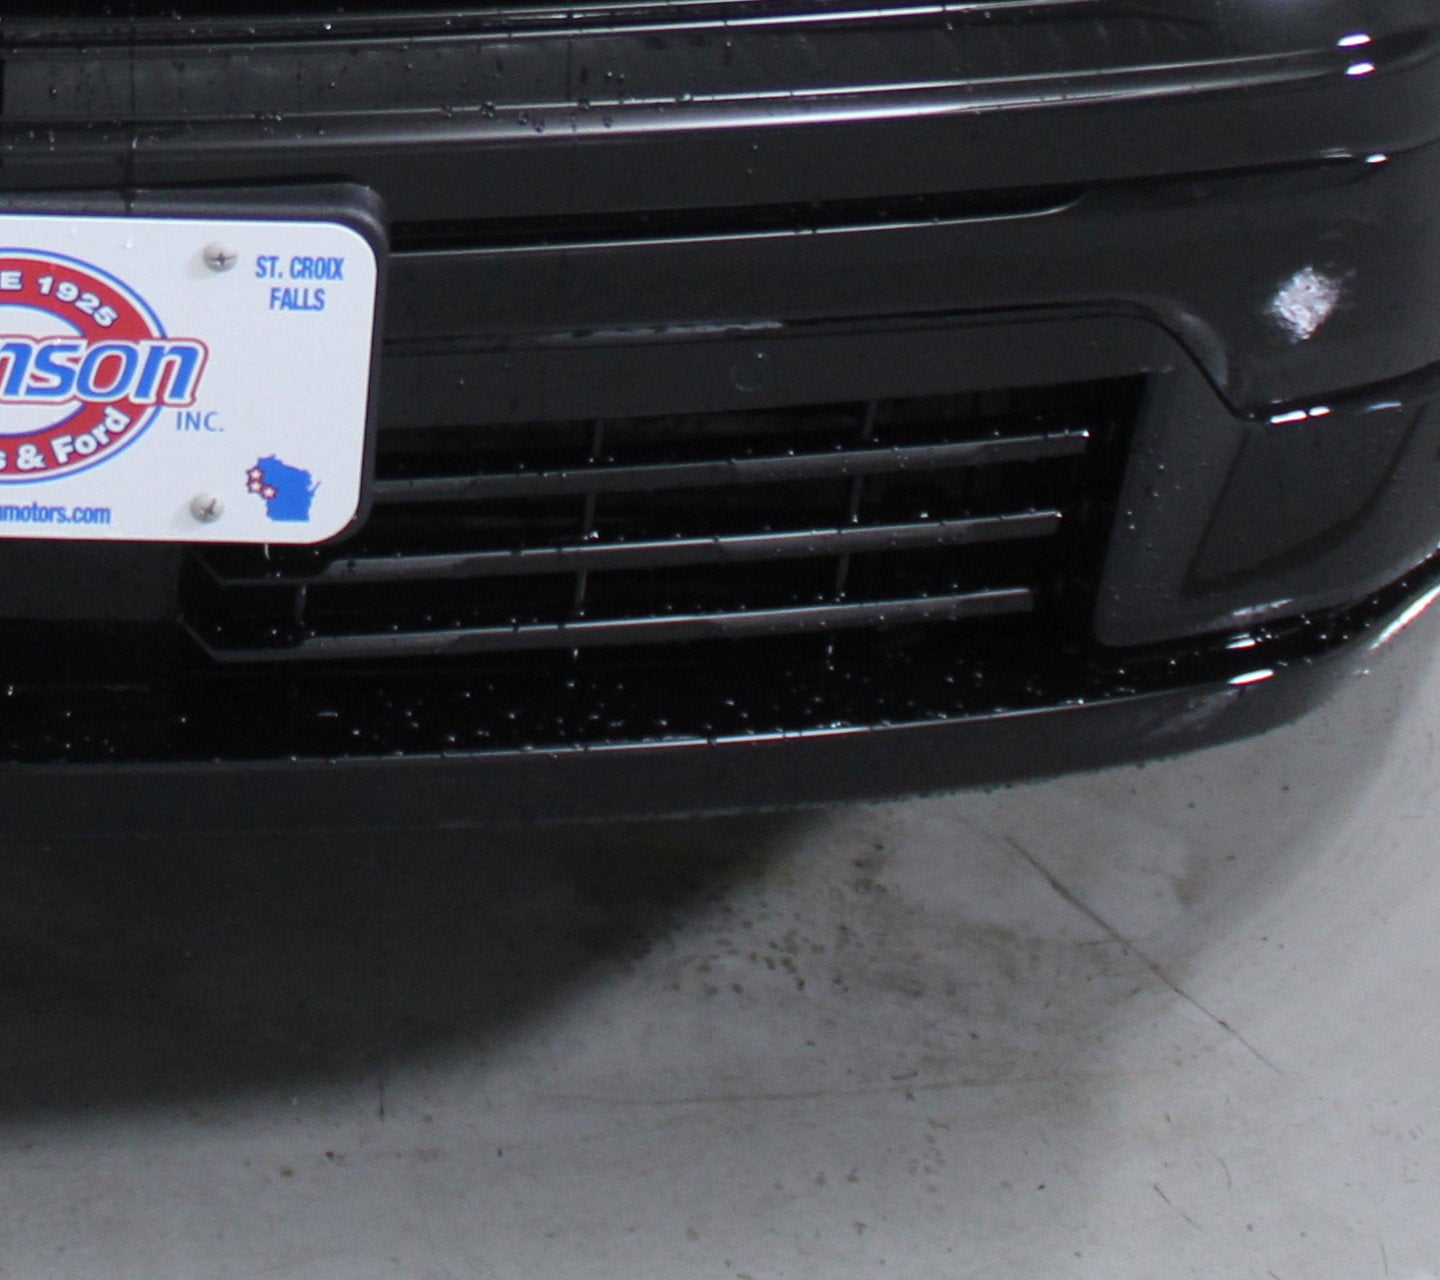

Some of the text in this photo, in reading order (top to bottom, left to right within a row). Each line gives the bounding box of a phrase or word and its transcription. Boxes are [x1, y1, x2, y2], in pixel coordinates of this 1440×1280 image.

[255, 255, 344, 280] ST. CROIX
[37, 274, 120, 329] 1925
[270, 288, 325, 311] FALLS
[176, 411, 225, 432] INC.
[16, 442, 47, 472] &
[51, 405, 133, 464] Ford
